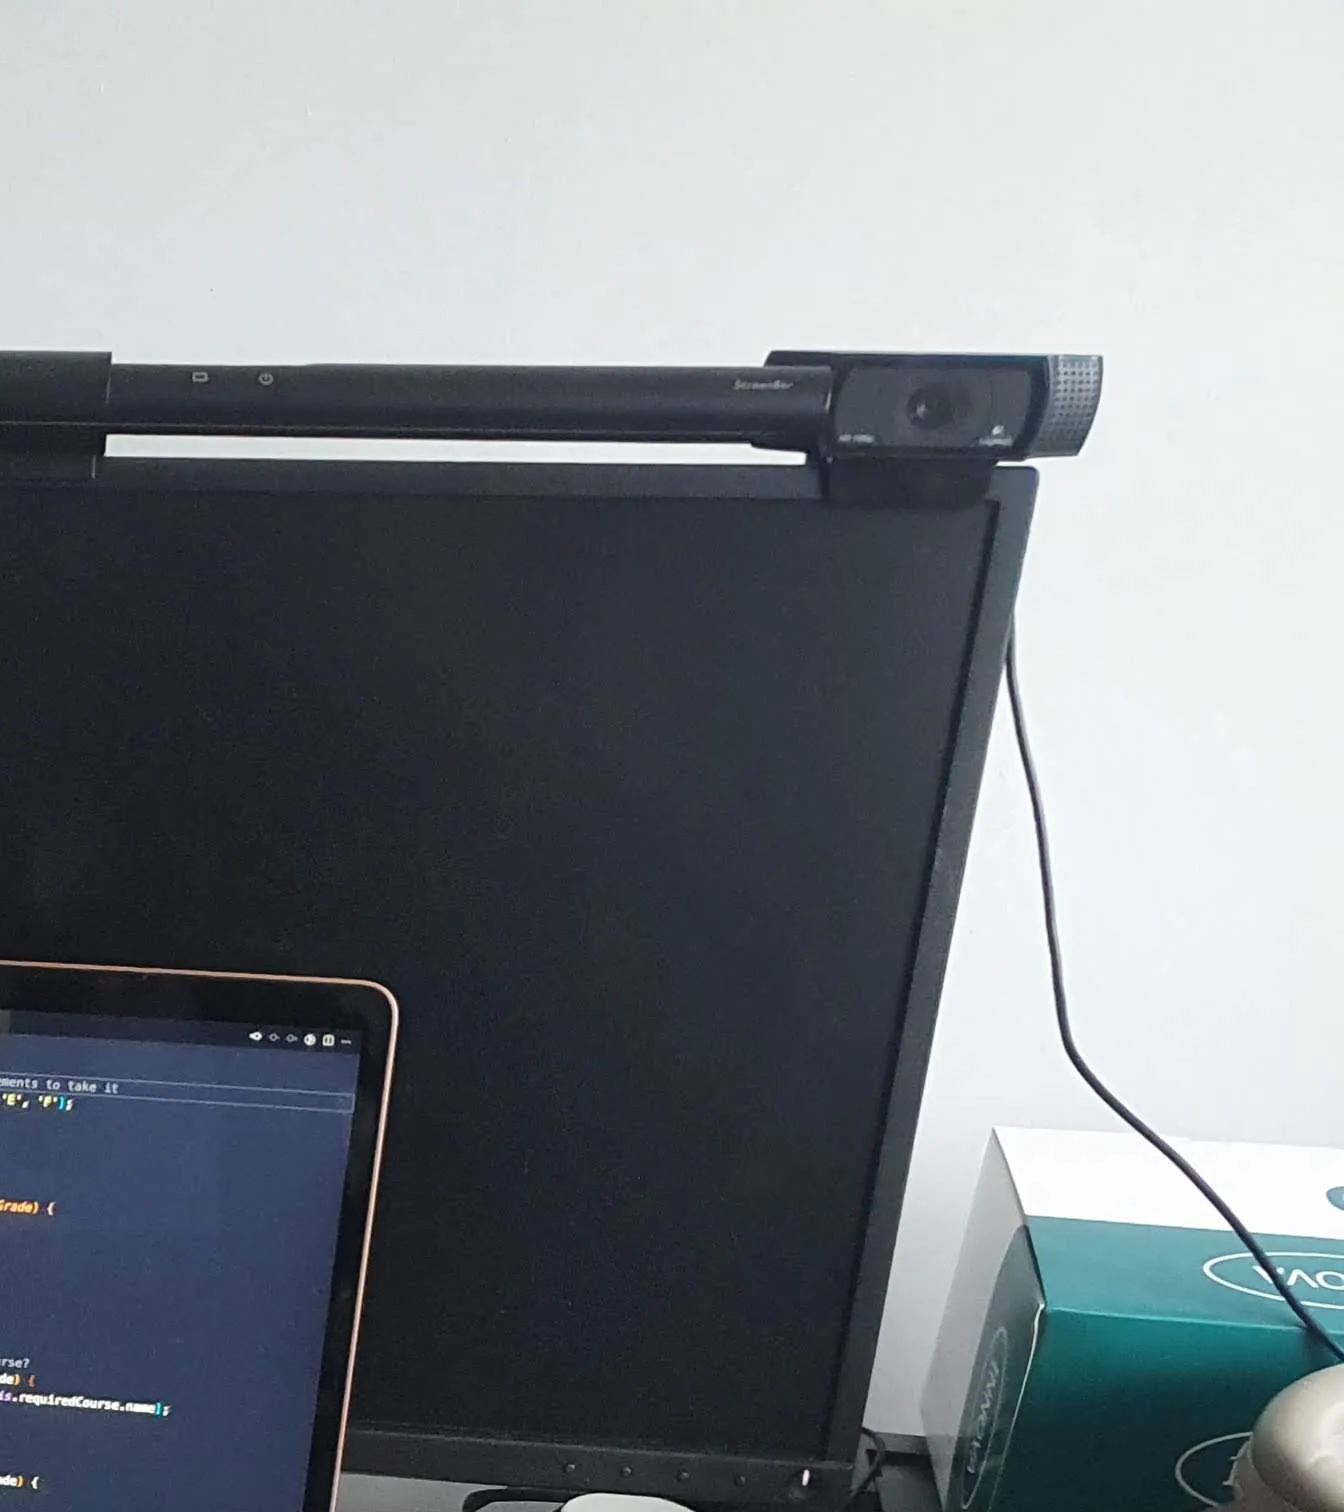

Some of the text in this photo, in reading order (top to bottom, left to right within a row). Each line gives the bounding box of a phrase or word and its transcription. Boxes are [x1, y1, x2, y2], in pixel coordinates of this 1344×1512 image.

[47, 1079, 61, 1090] to
[68, 1080, 97, 1093] take
[104, 1081, 119, 1094] it
